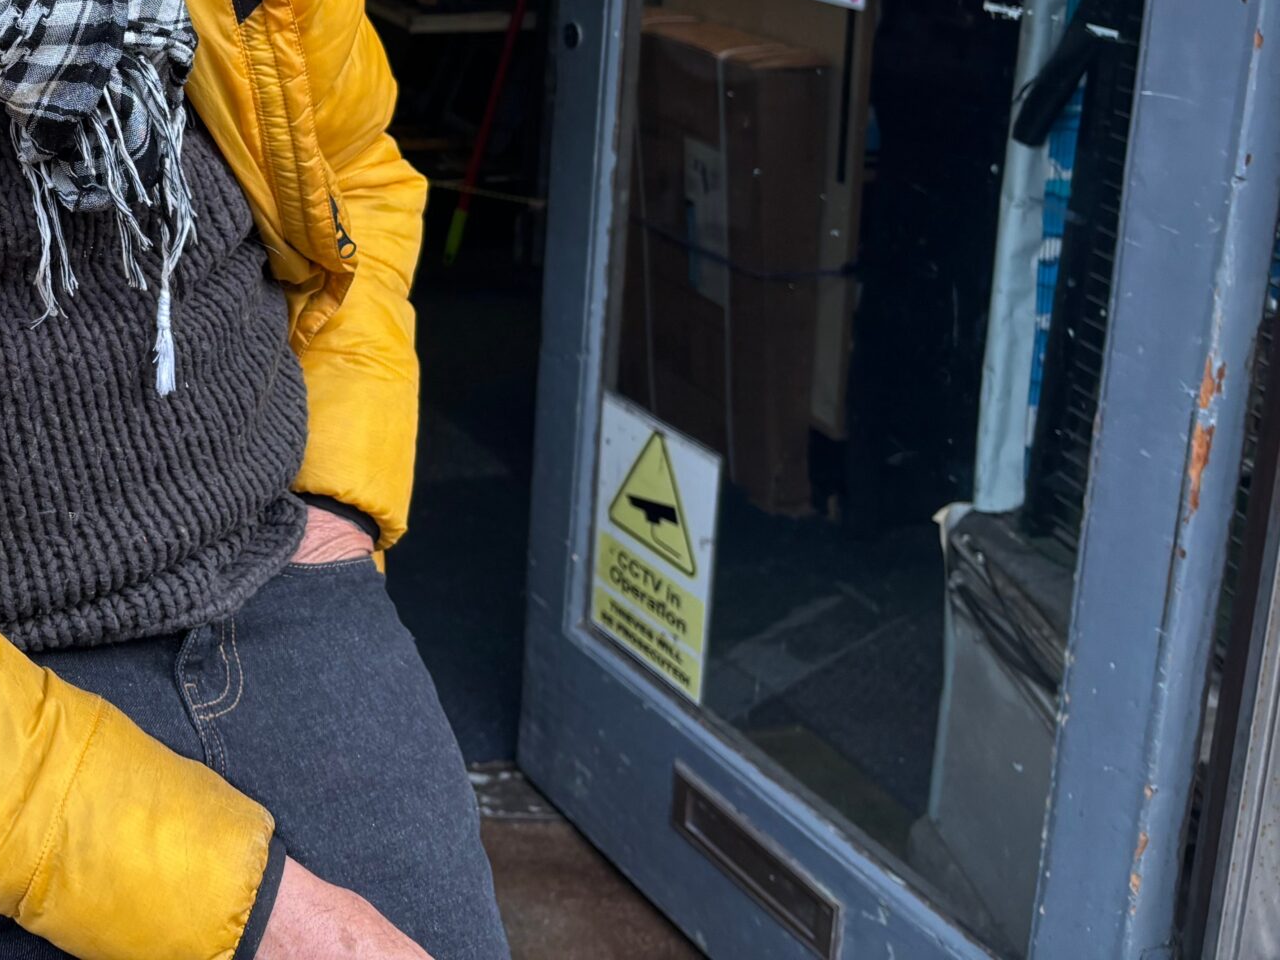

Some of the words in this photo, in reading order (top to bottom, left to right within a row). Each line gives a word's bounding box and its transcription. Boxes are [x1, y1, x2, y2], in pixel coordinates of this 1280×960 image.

[609, 565, 687, 634] Operation
[617, 550, 663, 592] CCTV
[666, 583, 682, 608] in
[608, 597, 654, 640] THIEVES
